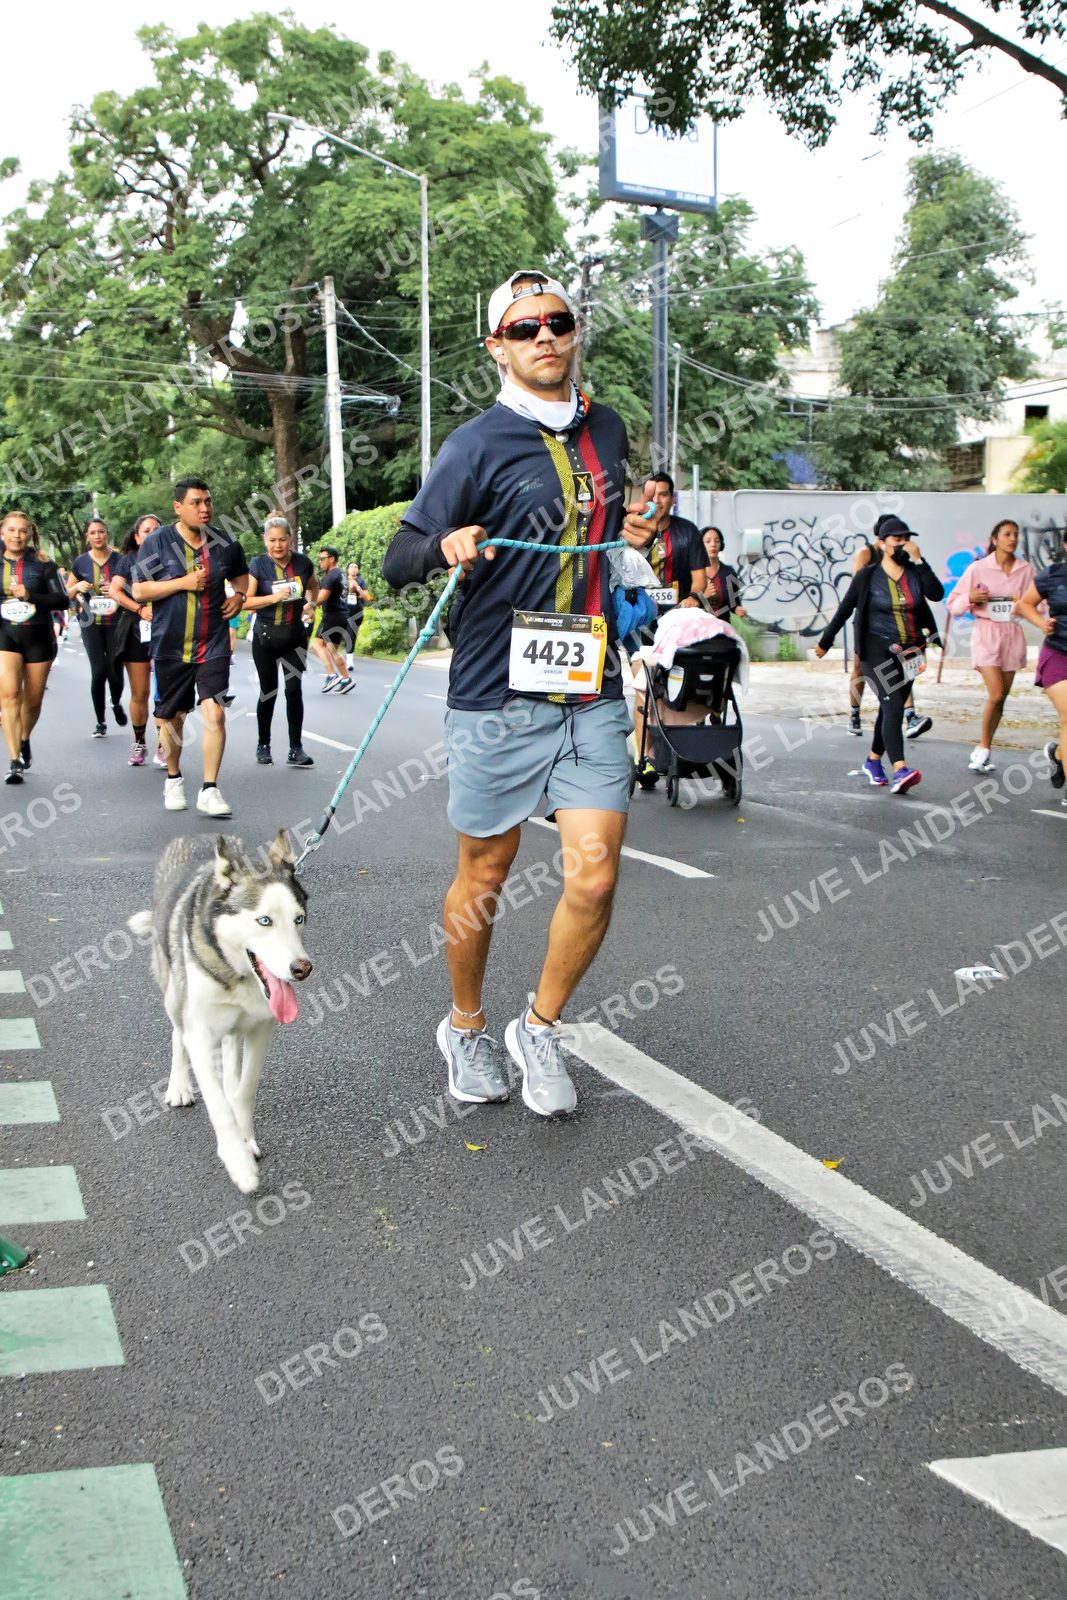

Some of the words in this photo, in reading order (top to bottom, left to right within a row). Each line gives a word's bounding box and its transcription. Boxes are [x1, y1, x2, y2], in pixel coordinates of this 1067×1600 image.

[763, 516, 817, 537] TOY
[991, 604, 1012, 613] 4307
[593, 623, 605, 633] 5K
[523, 640, 584, 667] 4423
